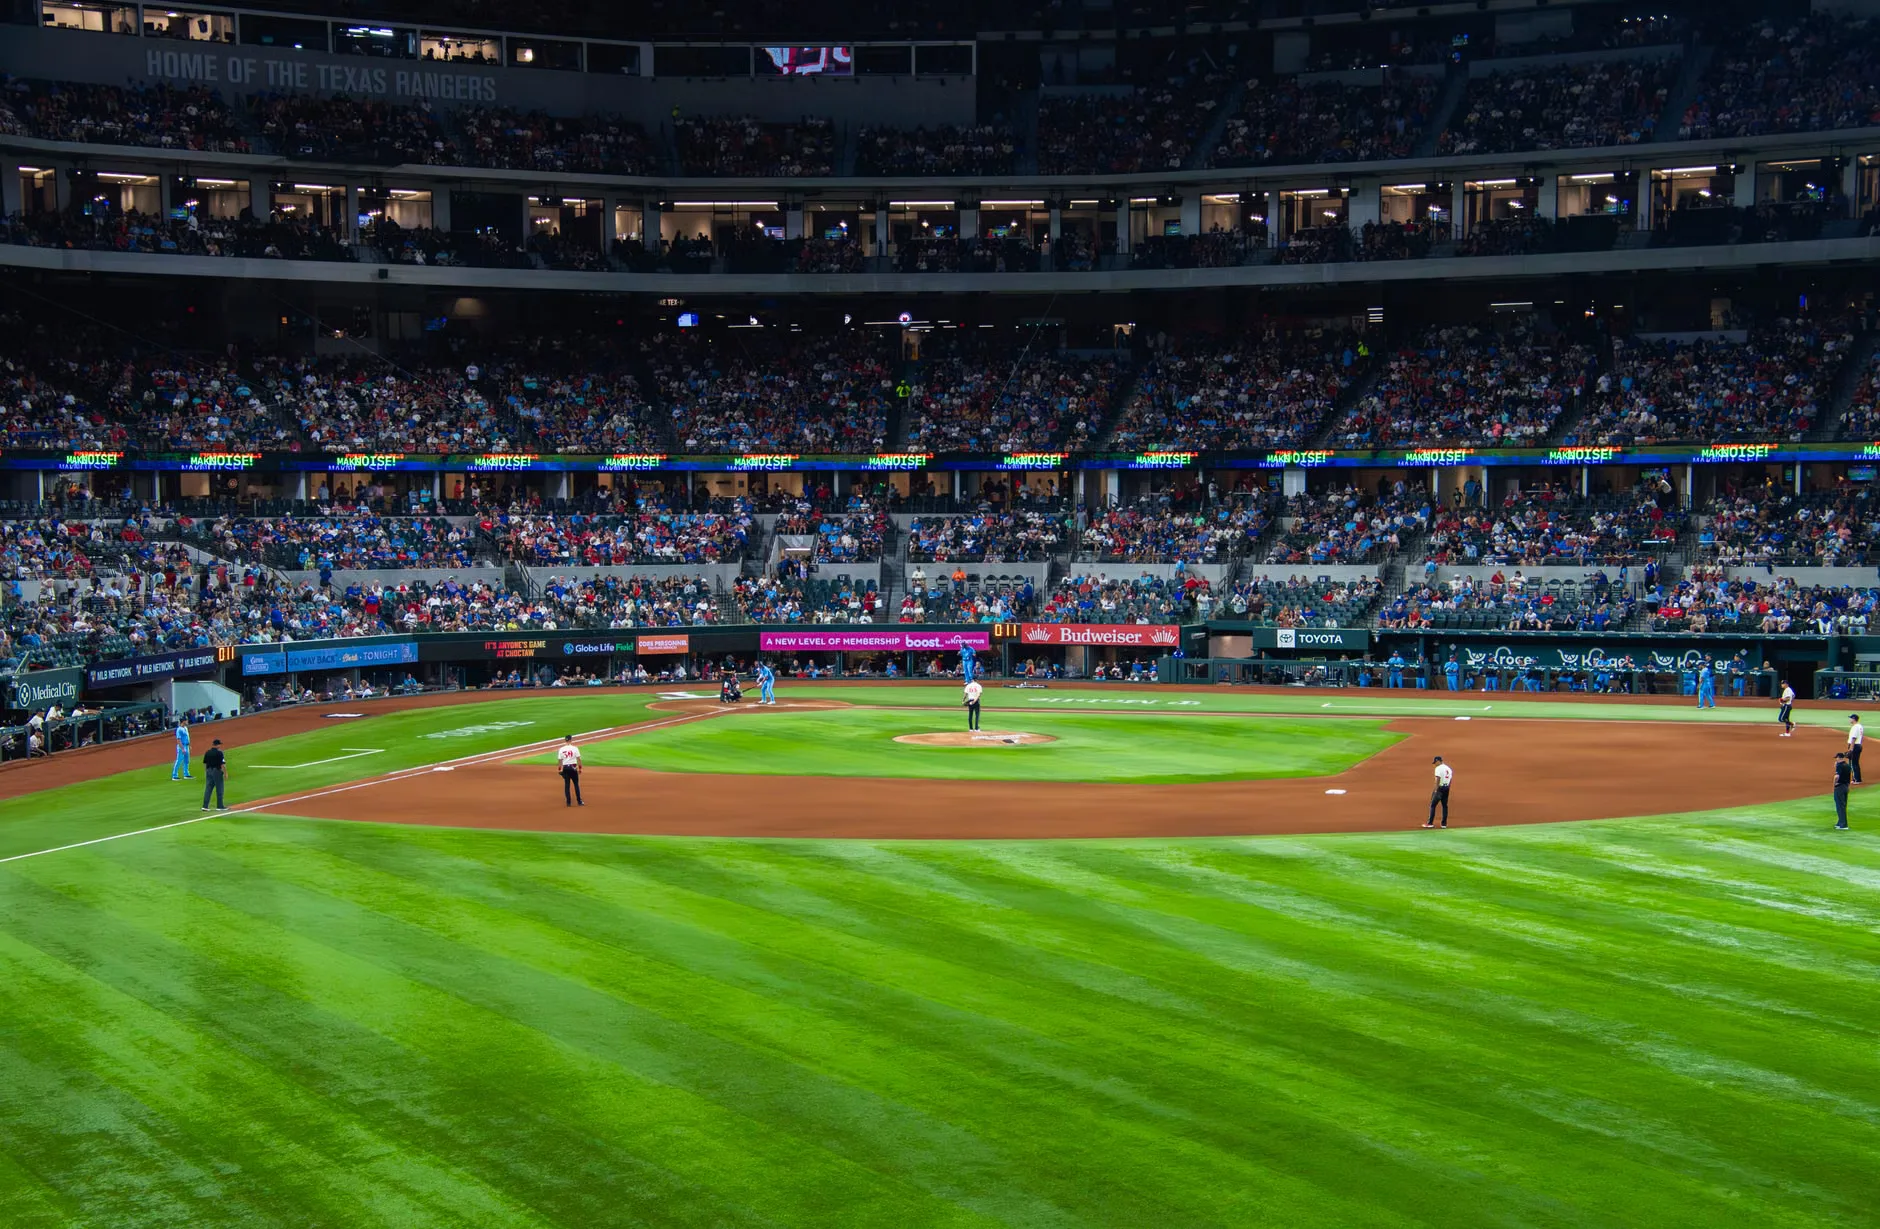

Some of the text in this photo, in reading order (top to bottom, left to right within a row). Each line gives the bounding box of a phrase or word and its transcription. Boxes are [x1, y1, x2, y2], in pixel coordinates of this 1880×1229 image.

[147, 50, 496, 101] HOME OF THE TEXAS RANGERS
[905, 635, 940, 648] boost
[1059, 627, 1142, 643] Budweiser
[1299, 634, 1343, 644] TOYOTA
[484, 640, 546, 650] IT'S ANYONE'S GAME
[575, 643, 634, 652] Globe Life Field
[363, 649, 398, 661] TONIGHT
[496, 649, 535, 658] AT CHOCTAW
[184, 655, 215, 669] MLB NETWORK
[301, 656, 316, 665] WAY
[97, 667, 132, 681] MLB NETWORK
[142, 661, 175, 675] MLB NETWORK
[32, 682, 76, 701] Medical City
